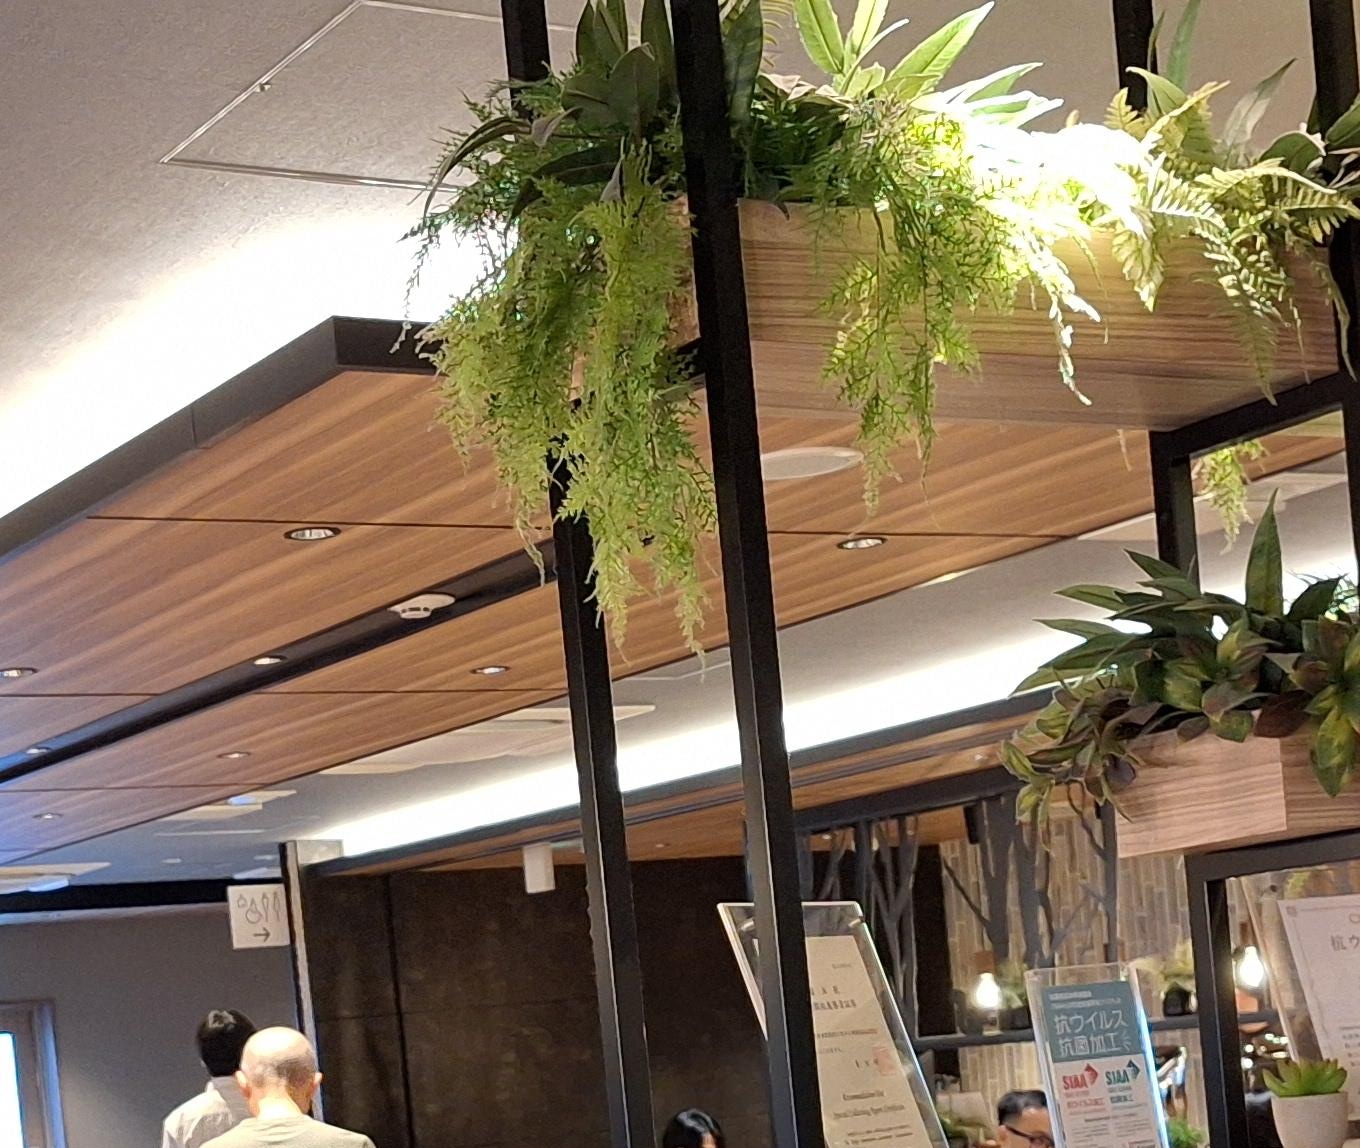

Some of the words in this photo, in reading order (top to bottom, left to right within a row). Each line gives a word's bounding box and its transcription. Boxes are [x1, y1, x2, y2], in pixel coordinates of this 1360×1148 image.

[1054, 1009, 1129, 1035] 抗ウイルス
[1059, 1032, 1122, 1057] 抗菌加工
[1062, 1073, 1088, 1090] SIAA
[1105, 1068, 1130, 1086] SIAA
